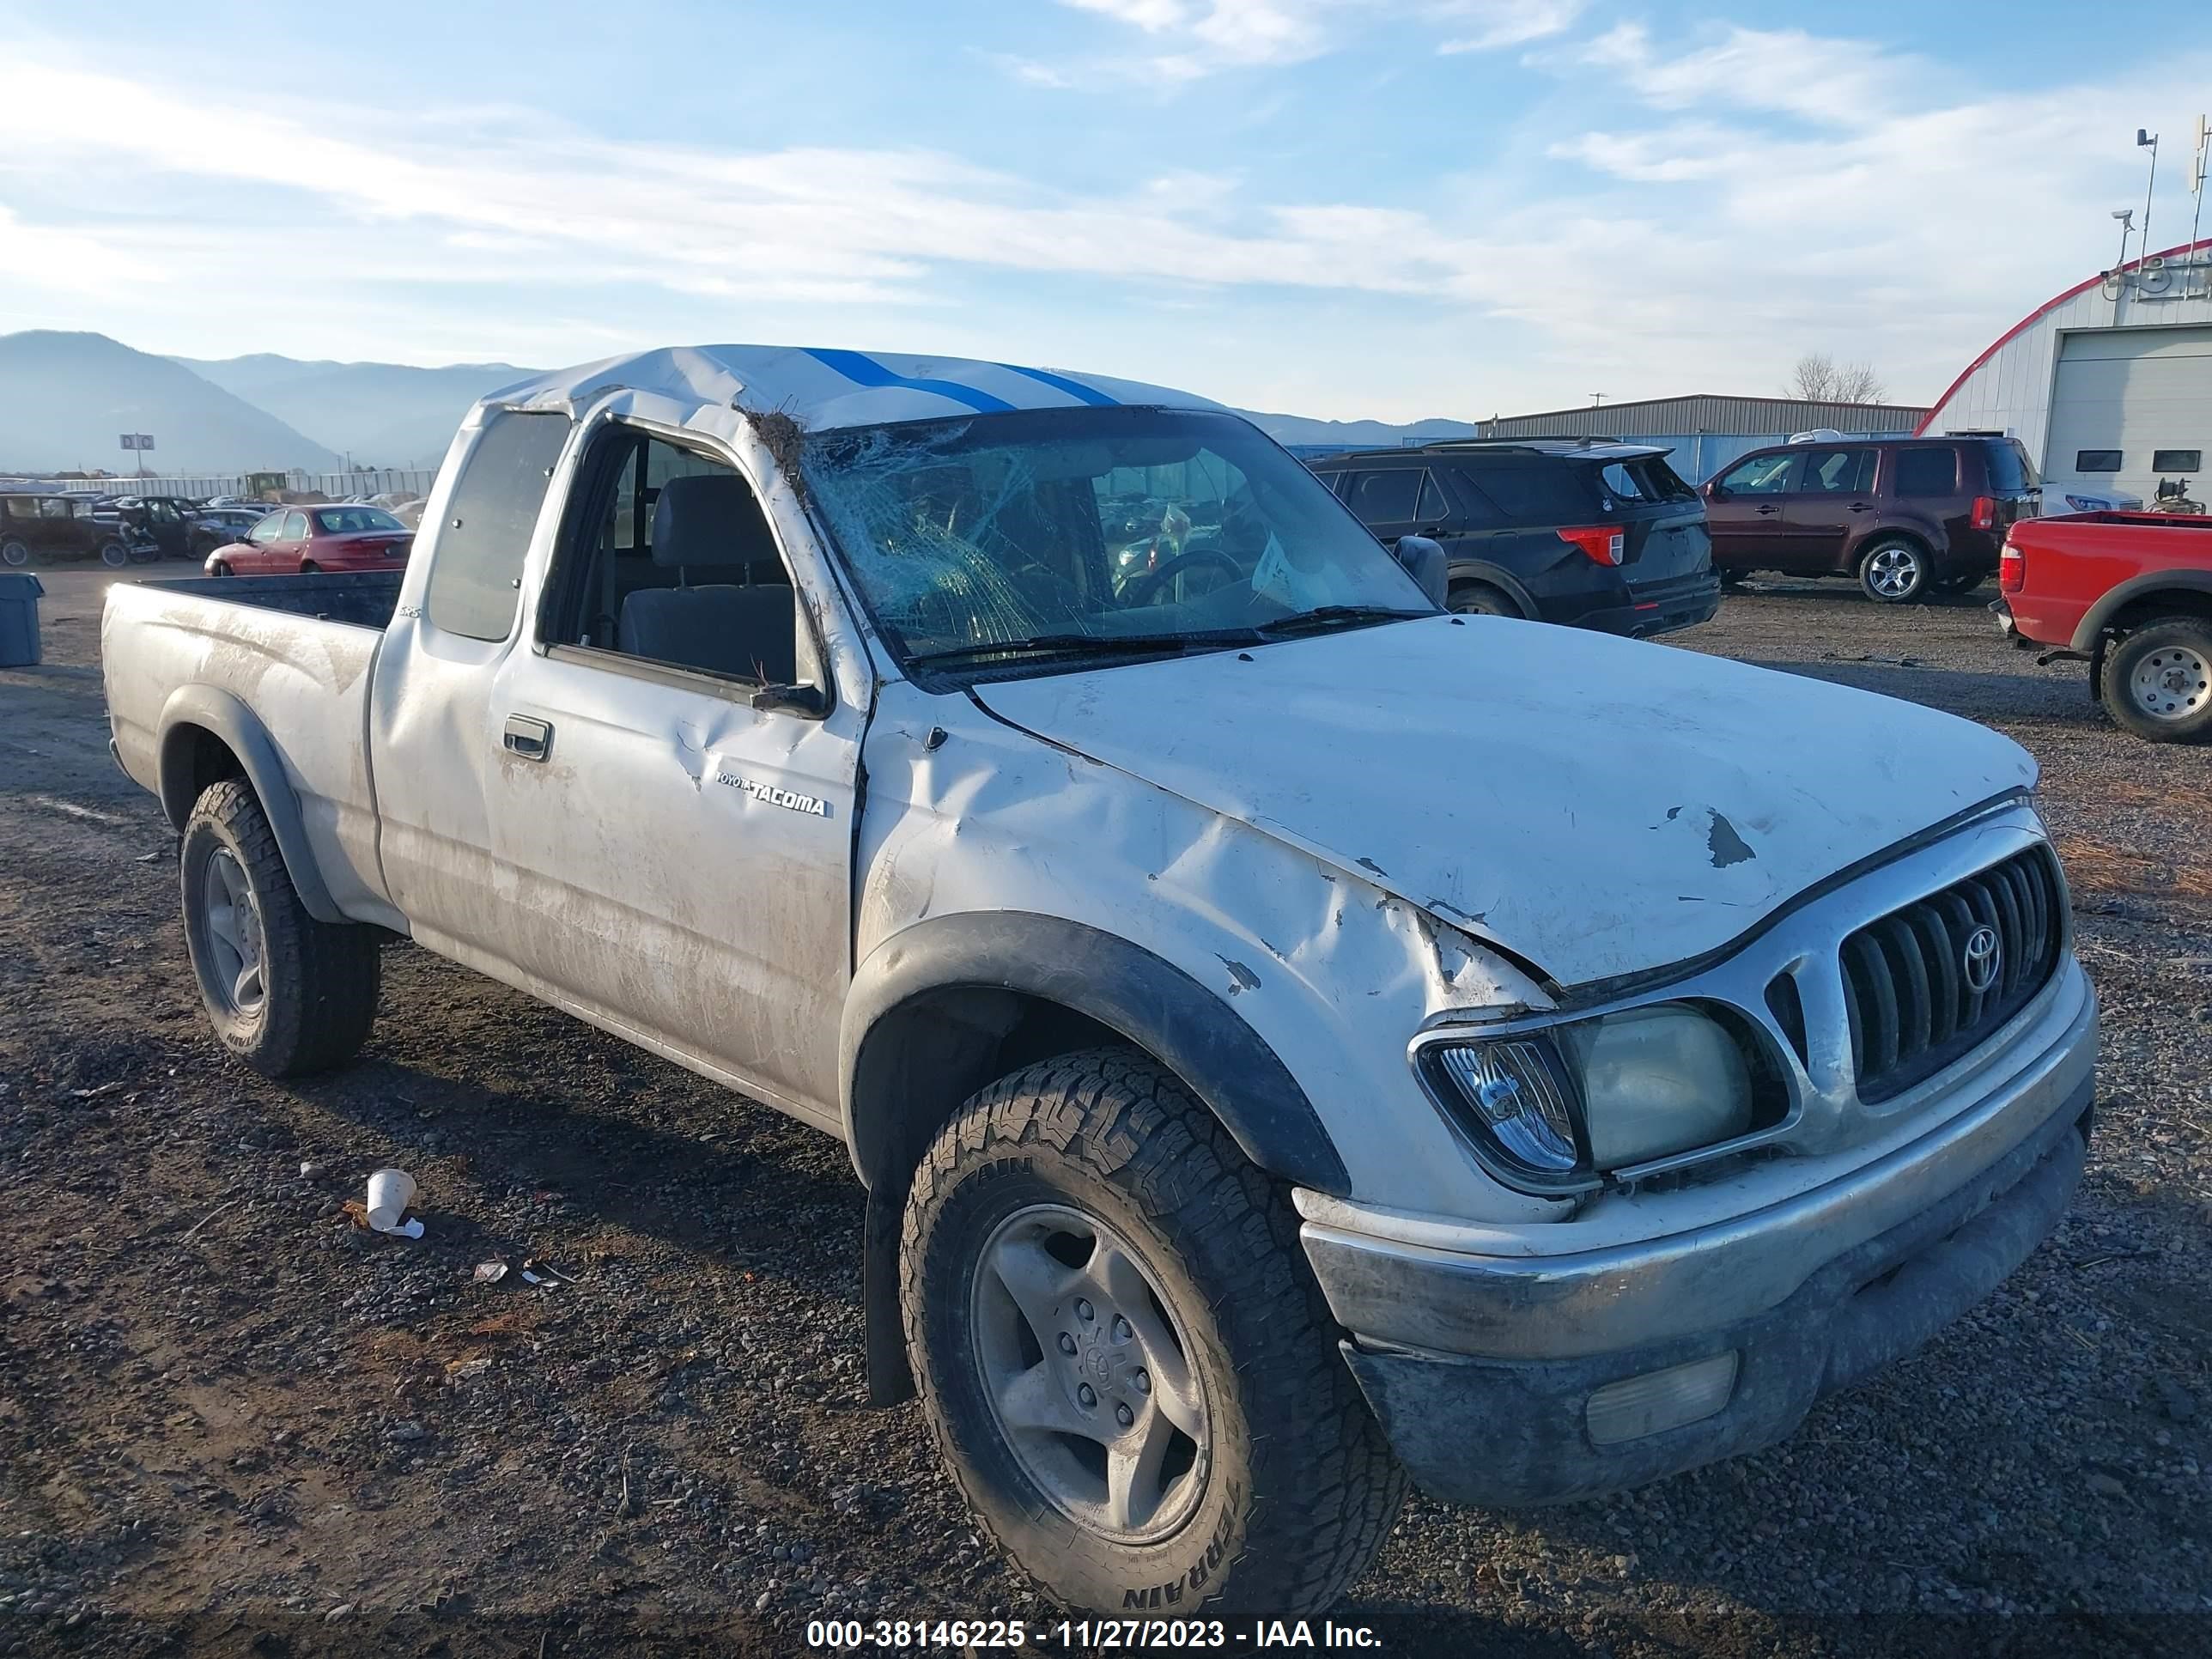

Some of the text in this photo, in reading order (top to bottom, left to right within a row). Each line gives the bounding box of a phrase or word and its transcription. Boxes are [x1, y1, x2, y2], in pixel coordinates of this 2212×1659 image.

[123, 436, 151, 448] D C
[399, 605, 422, 618] SR5
[715, 771, 824, 816] TOYOTA TACOMA
[1121, 1476, 1242, 1610] TERRAIN
